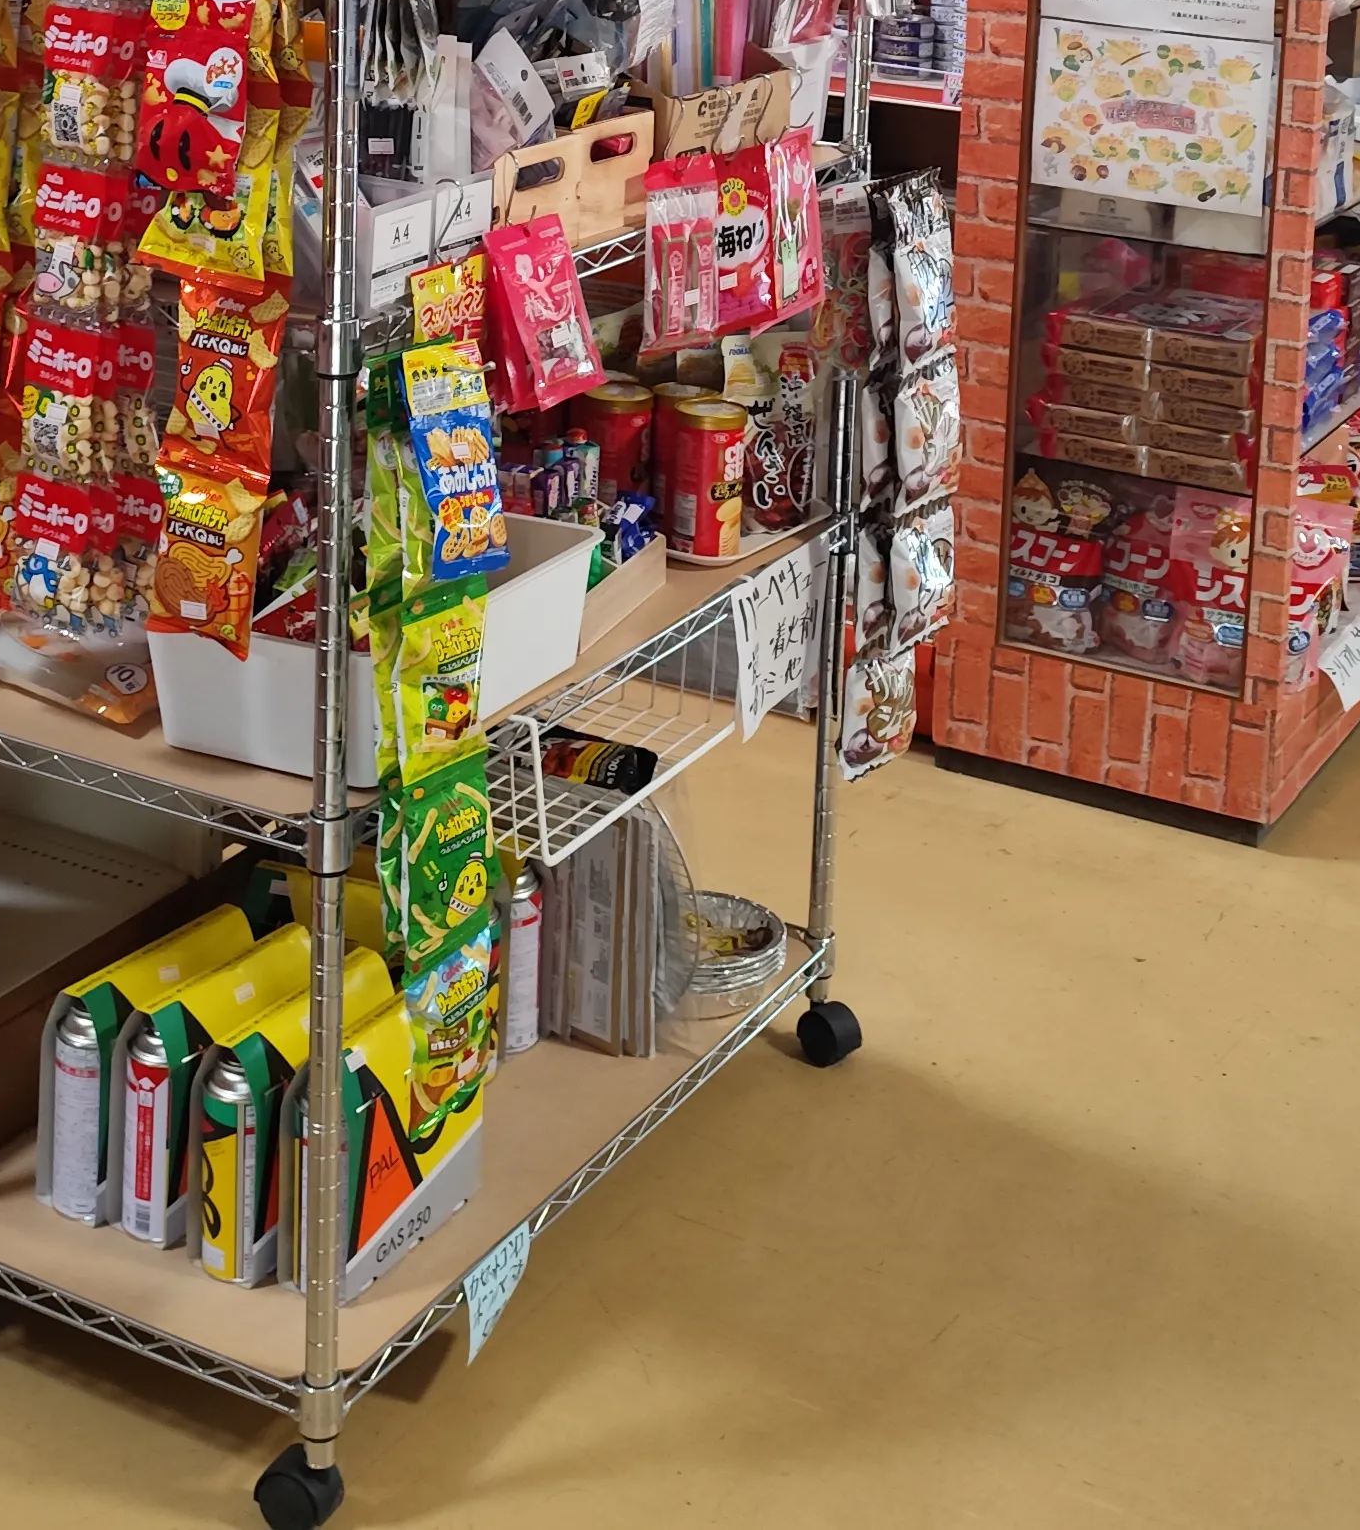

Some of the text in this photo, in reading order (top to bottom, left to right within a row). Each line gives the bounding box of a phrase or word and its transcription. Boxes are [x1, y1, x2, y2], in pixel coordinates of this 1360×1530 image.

[44, 22, 110, 58] ミニボーロ
[34, 185, 101, 218] ミニボーロ
[715, 219, 766, 261] 梅ねり
[194, 307, 253, 341] サッポロポテト
[420, 286, 486, 333] スッパイマン
[26, 343, 93, 380] ミニボーロ
[190, 332, 249, 358] バーベQあじ
[438, 461, 497, 495] あみじゃが
[17, 494, 89, 535] ミニボーロ
[168, 495, 230, 532] サッポロポテト
[168, 520, 224, 547] バーベQあじ
[738, 558, 828, 643] バーベキュー
[1194, 576, 1246, 607] シス
[769, 599, 819, 659] 着火剤
[436, 805, 482, 845] サッポロポテト
[435, 969, 485, 1015] サッポロポテト
[369, 1146, 399, 1190] PAL
[374, 1204, 433, 1264] GAS 250
